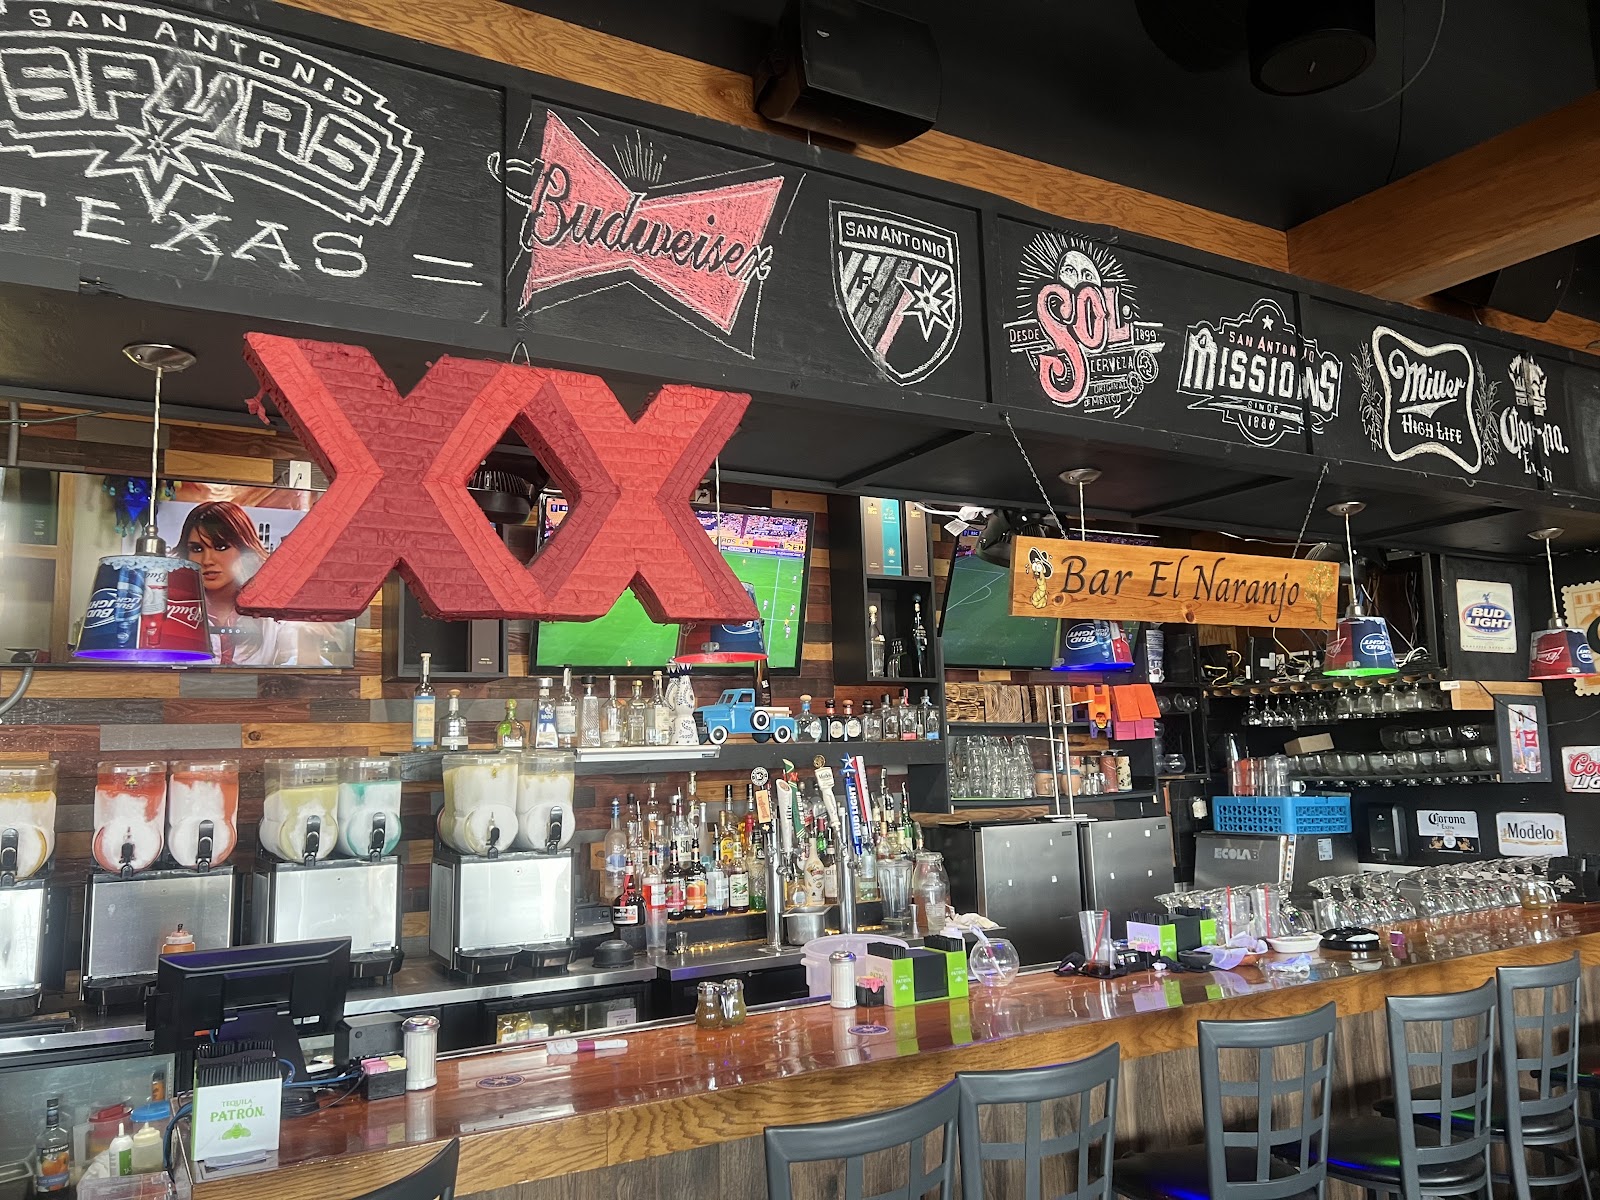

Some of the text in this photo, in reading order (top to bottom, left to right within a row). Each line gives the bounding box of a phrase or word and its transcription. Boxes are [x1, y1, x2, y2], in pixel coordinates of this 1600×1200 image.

[30, 9, 363, 103] SAN ANTONIO
[521, 161, 773, 282] Budweiser
[0, 186, 368, 279] TEXAS
[845, 220, 947, 259] SAN ANTONIO
[1009, 327, 1041, 343] DESDE
[1229, 331, 1315, 363] SAN ANTONIO
[1090, 356, 1134, 373] CERVEZA
[1182, 328, 1338, 412] MISSIONS
[1388, 349, 1466, 402] Miller
[1094, 381, 1127, 394] ORIGINAL
[1247, 401, 1279, 414] SINCE
[1248, 415, 1276, 431] 1888
[1401, 413, 1463, 445] HIGH LIFE
[1060, 555, 1301, 623] Bar El Naranjo
[87, 599, 117, 608] IGHT
[117, 597, 141, 605] LIGH
[1471, 608, 1506, 618] BUD
[1466, 617, 1511, 629] LIGHT
[848, 786, 862, 837] BUD LIGHT
[1428, 812, 1466, 825] Corona
[1507, 823, 1554, 840] Modelo
[222, 1098, 252, 1107] TEQUILA
